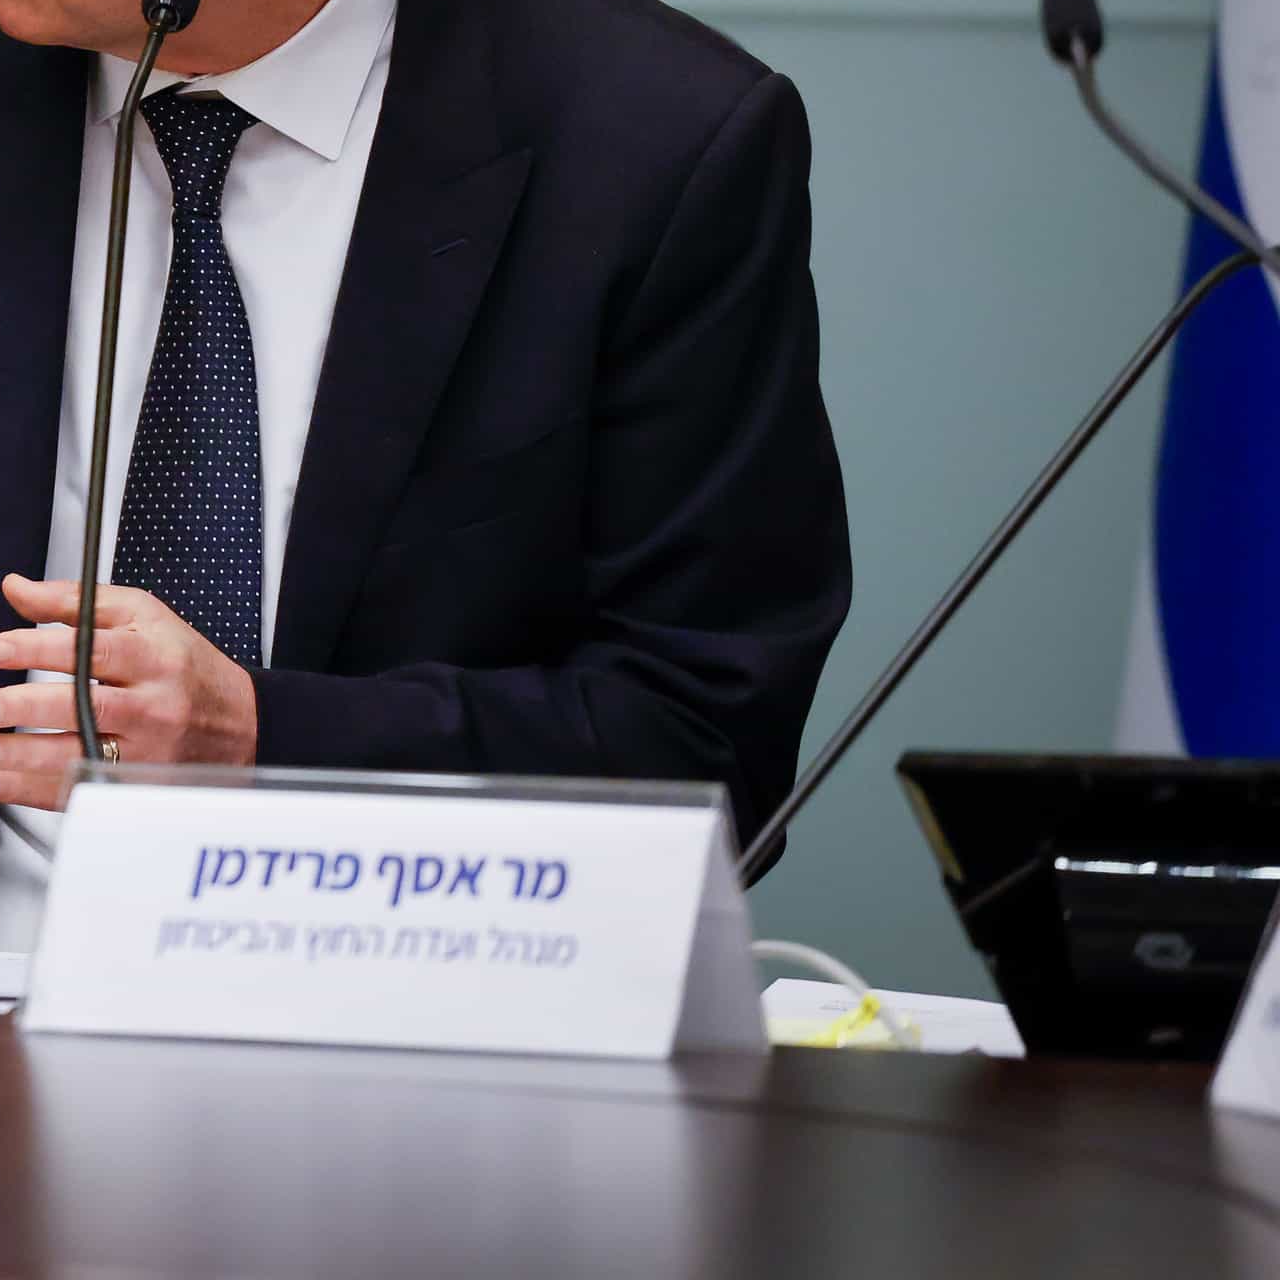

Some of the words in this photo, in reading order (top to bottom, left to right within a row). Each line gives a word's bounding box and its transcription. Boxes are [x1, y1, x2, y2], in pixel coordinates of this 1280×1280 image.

[190, 845, 363, 901] פרידמן
[378, 854, 487, 908] אסף
[503, 856, 570, 902] מר
